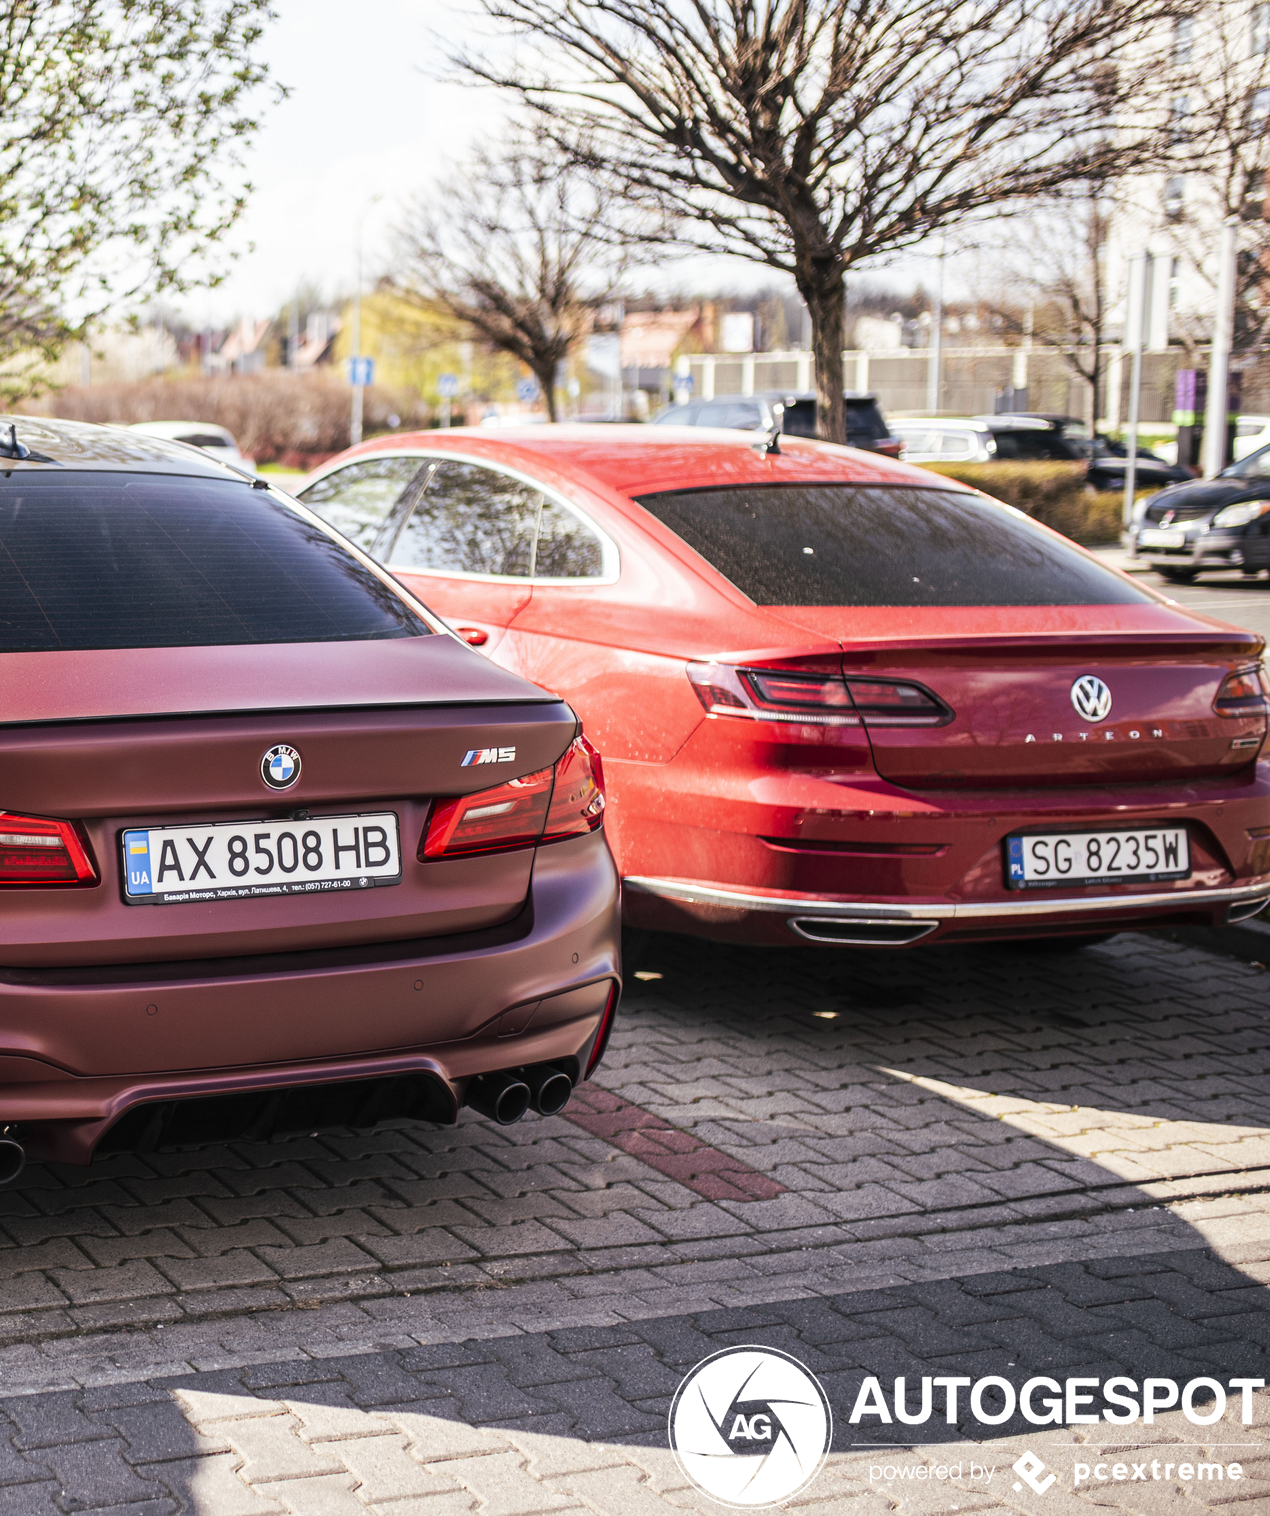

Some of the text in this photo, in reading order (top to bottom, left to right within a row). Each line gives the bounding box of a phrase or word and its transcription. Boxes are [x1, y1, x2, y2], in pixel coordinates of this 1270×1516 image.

[1025, 729, 1162, 743] ARTEON
[266, 746, 299, 761] BMW
[157, 825, 391, 883] AX 8508 HB
[1032, 833, 1179, 875] SG 8235W
[1011, 864, 1023, 875] PL
[131, 870, 150, 885] UA
[321, 880, 351, 889] 727-61-00
